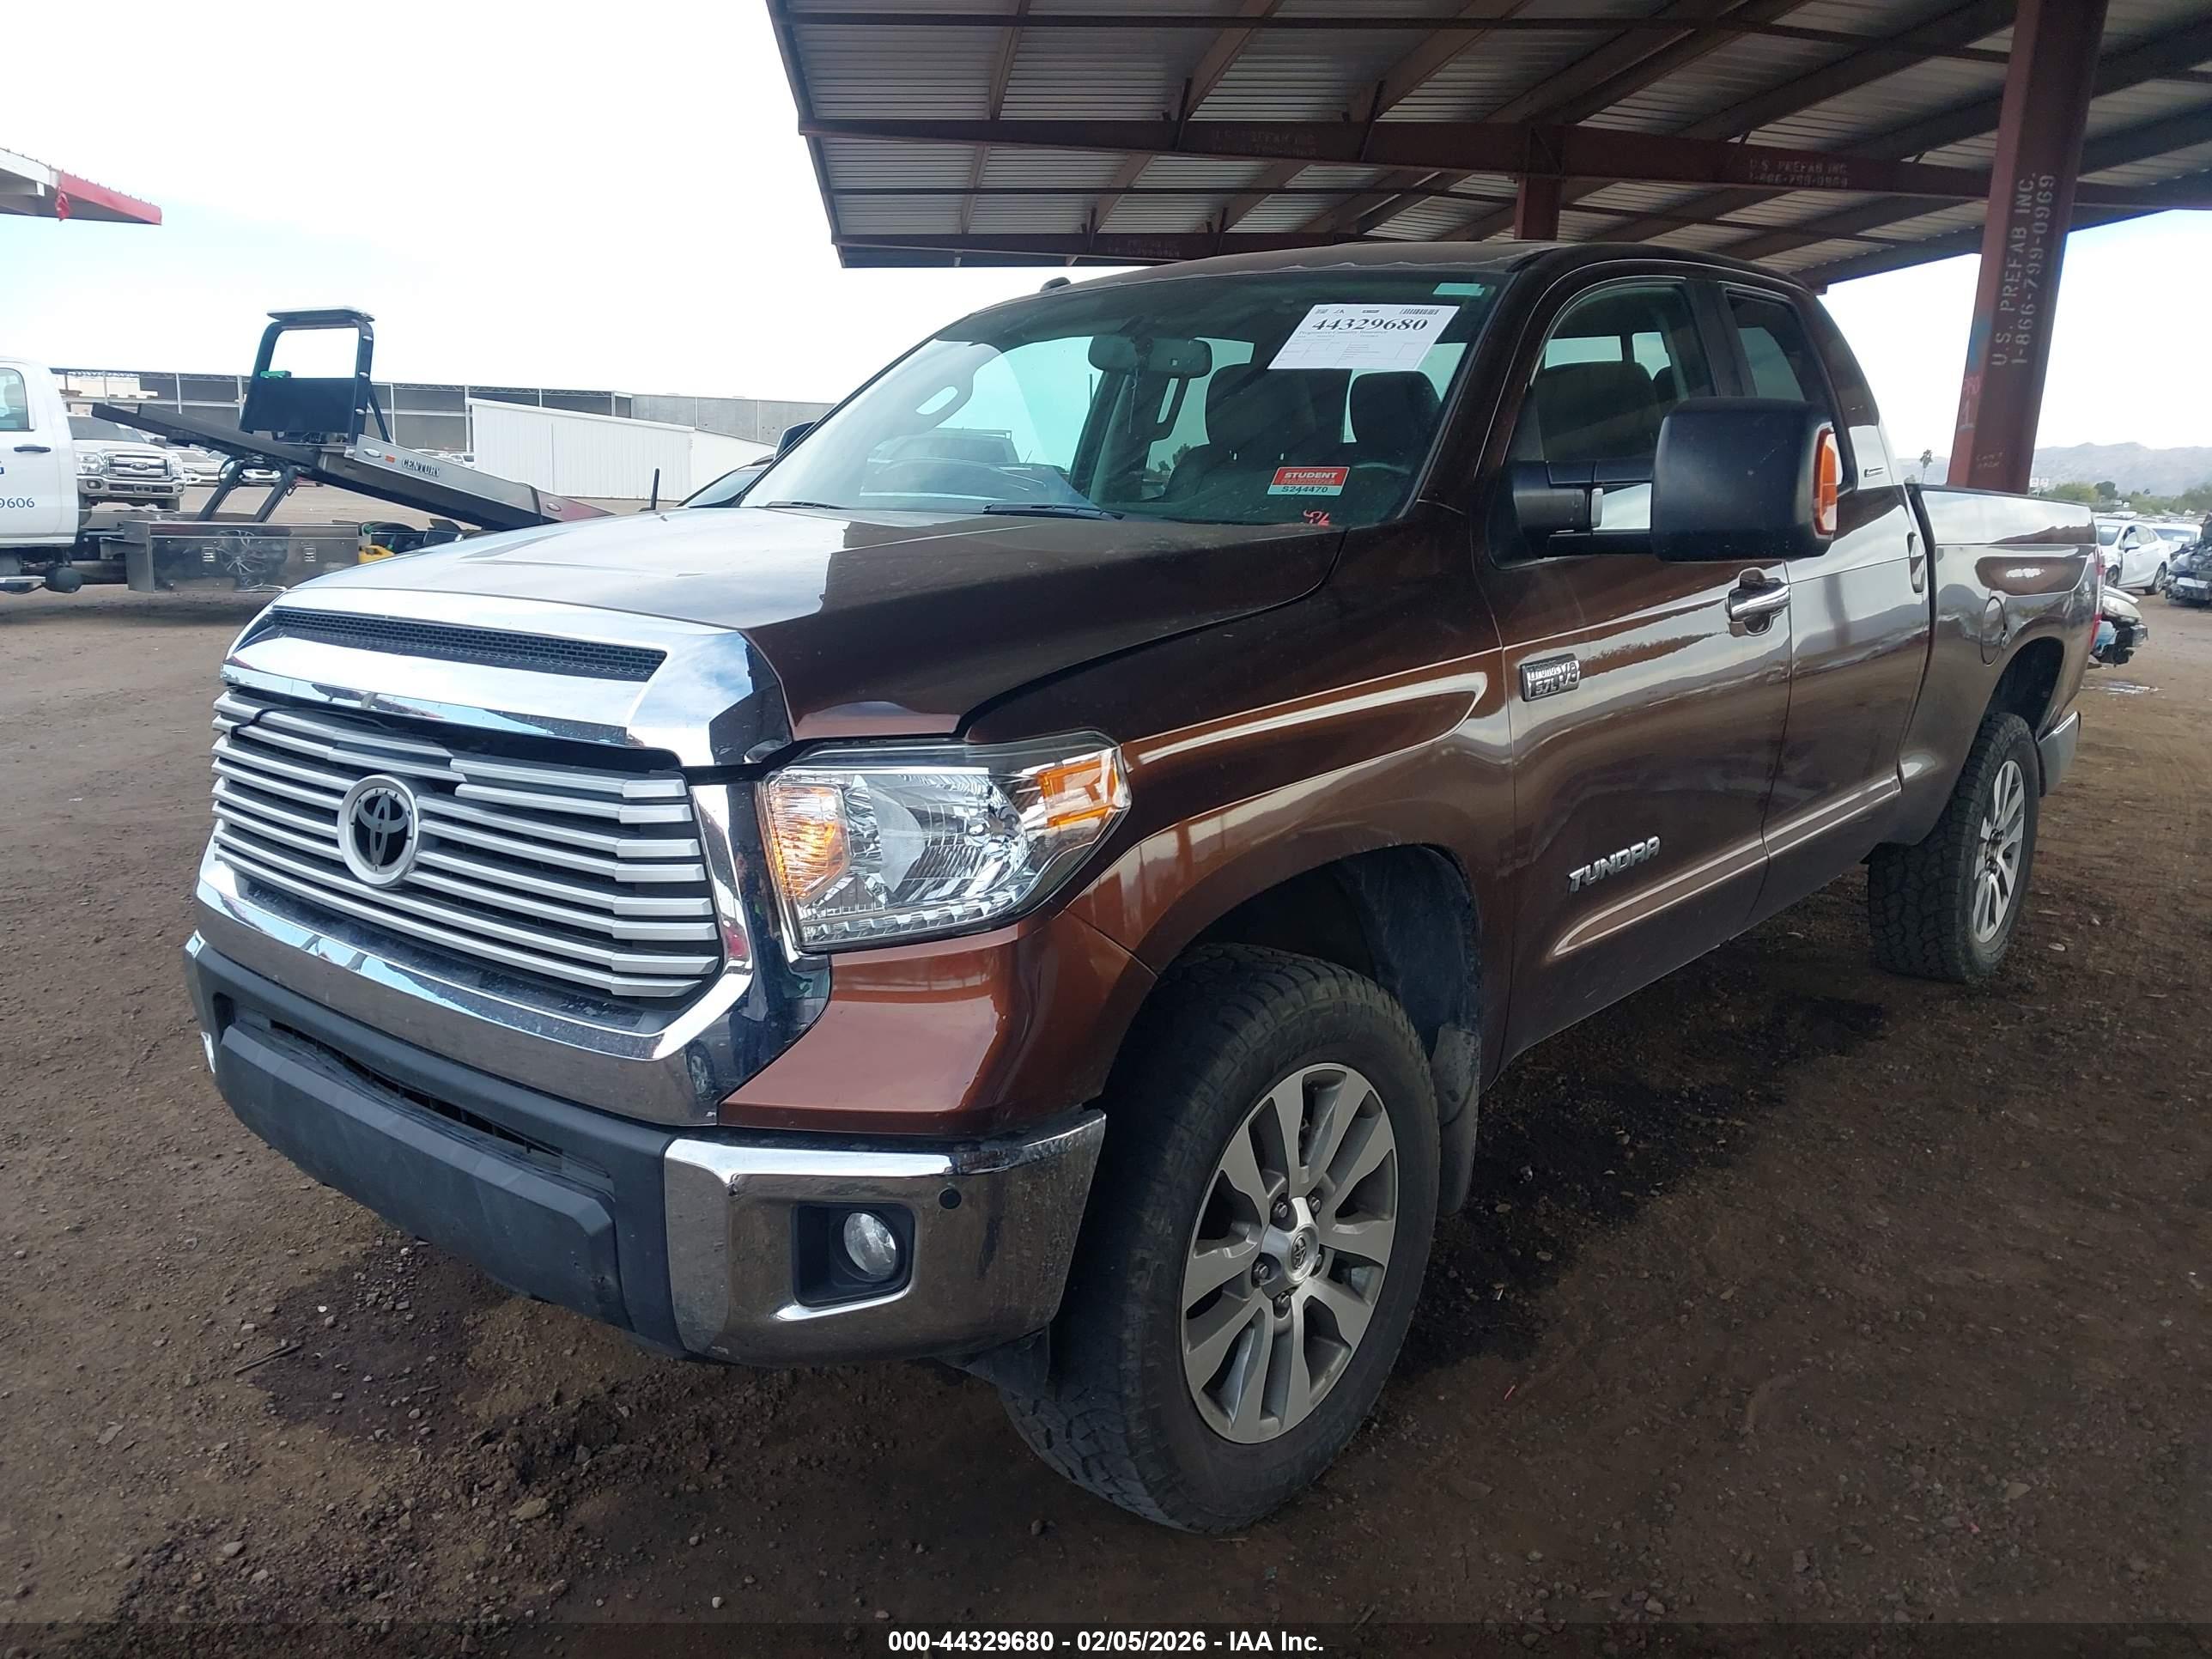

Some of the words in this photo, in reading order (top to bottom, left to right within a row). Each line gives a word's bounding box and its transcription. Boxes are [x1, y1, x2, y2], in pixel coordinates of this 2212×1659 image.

[2014, 173, 2036, 215] INC.
[1999, 226, 2027, 313] PREFAB
[2010, 174, 2056, 365] 1-866-799-0969
[1312, 319, 1428, 331] 44329680
[1991, 325, 2014, 366] U.S.
[402, 459, 440, 477] CENTURY
[1569, 836, 1661, 892] TUNDRA
